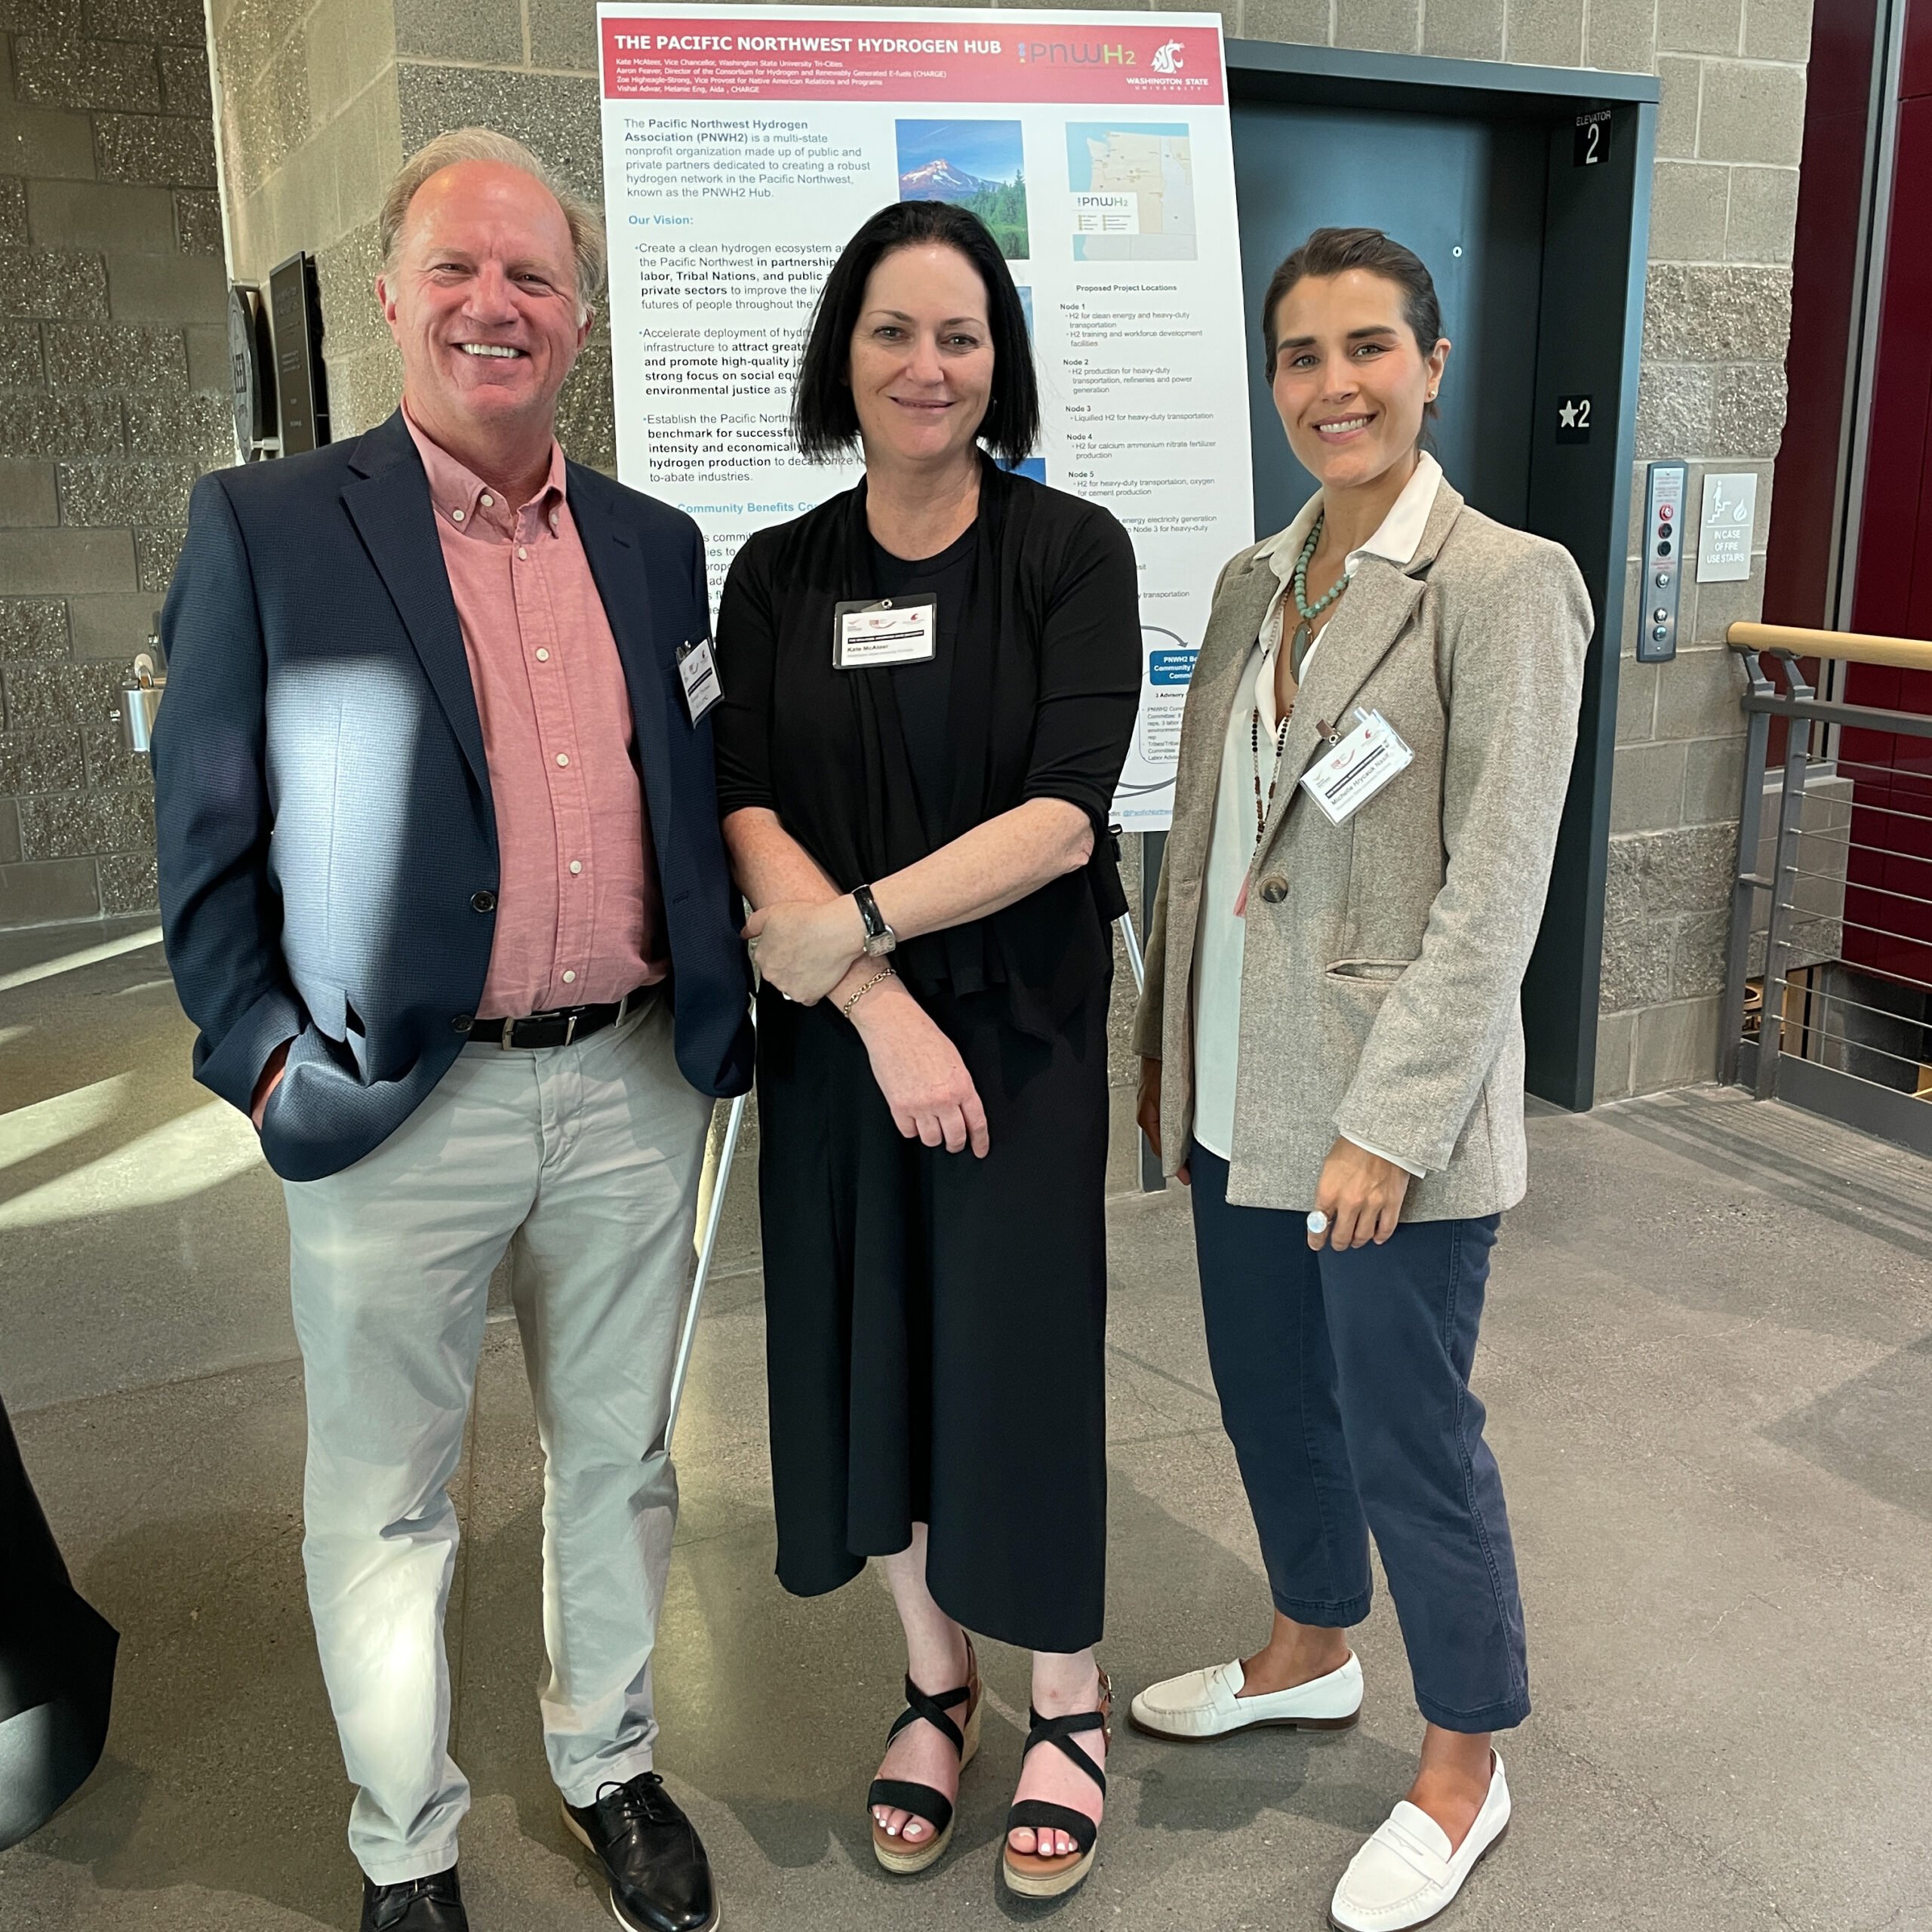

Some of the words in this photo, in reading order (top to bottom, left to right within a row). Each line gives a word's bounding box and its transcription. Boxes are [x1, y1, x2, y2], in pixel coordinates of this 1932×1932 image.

[614, 35, 651, 49] THE
[657, 35, 732, 50] PACIFIC
[737, 36, 852, 51] NORTHWEST
[858, 38, 958, 53] HYDROGEN
[964, 41, 1001, 53] HUB
[1576, 110, 1611, 126] ELEVATOR
[624, 118, 645, 127] The
[648, 119, 687, 128] Pacific
[691, 119, 749, 128] Northwest
[752, 119, 808, 131] Hydrogen
[625, 132, 693, 141] Association
[697, 133, 747, 143] (PNWH2)
[1586, 123, 1599, 164] 2
[625, 146, 672, 157] nonprofit
[675, 146, 741, 157] organization
[745, 147, 774, 155] made
[794, 146, 804, 155] of
[808, 147, 838, 158] public
[841, 148, 861, 156] and
[626, 160, 662, 171] private
[666, 161, 709, 171] partners
[713, 160, 764, 169] dedicated
[782, 162, 824, 172] creating
[837, 162, 870, 170] robust
[626, 174, 677, 185] hydrogen
[681, 174, 722, 183] network
[759, 174, 794, 183] Pacific
[797, 174, 853, 184] Northwest,
[627, 187, 662, 196] known
[682, 188, 698, 196] the
[702, 187, 745, 196] PNWH2
[749, 188, 773, 196] Hub.
[629, 215, 650, 224] Our
[654, 215, 693, 224] Vision:
[638, 243, 675, 252] Create
[689, 244, 717, 252] clean
[721, 243, 771, 254] hydrogen
[774, 245, 832, 254] ecosystem
[640, 258, 656, 266] the
[660, 257, 695, 266] Pacific
[699, 257, 753, 266] Northwest
[757, 257, 767, 266] in
[771, 257, 836, 269] partnership
[640, 272, 672, 281] labor,
[676, 272, 708, 280] Tribal
[712, 272, 758, 281] Nations,
[763, 272, 783, 280] and
[788, 272, 822, 281] public
[643, 328, 700, 337] Accelerate
[703, 328, 766, 339] deployment
[770, 328, 779, 337] of
[644, 343, 714, 351] infrastructure
[732, 343, 768, 351] attract
[645, 357, 665, 365] and
[670, 358, 717, 368] promote
[721, 356, 789, 368] high-quality
[645, 372, 682, 382] strong
[687, 371, 718, 380] focus
[740, 371, 774, 380] social
[646, 385, 728, 394] environmental
[732, 385, 770, 396] justice
[648, 414, 696, 423] Establish
[700, 414, 716, 423] the
[720, 414, 755, 423] Pacific
[1578, 399, 1590, 427] 2
[648, 429, 712, 438] benchmark
[716, 429, 732, 437] for
[649, 444, 697, 454] intensity
[702, 443, 723, 452] and
[649, 458, 704, 469] hydrogen
[709, 457, 771, 468] production
[650, 472, 694, 481] to-abate
[698, 472, 752, 481] industries.
[678, 503, 743, 515] Community
[747, 502, 794, 512] Benefits
[1721, 530, 1741, 539] CASE
[1714, 542, 1724, 551] OF
[1724, 542, 1738, 551] FIRE
[1707, 554, 1720, 563] USE
[1721, 553, 1744, 563] STAIRS
